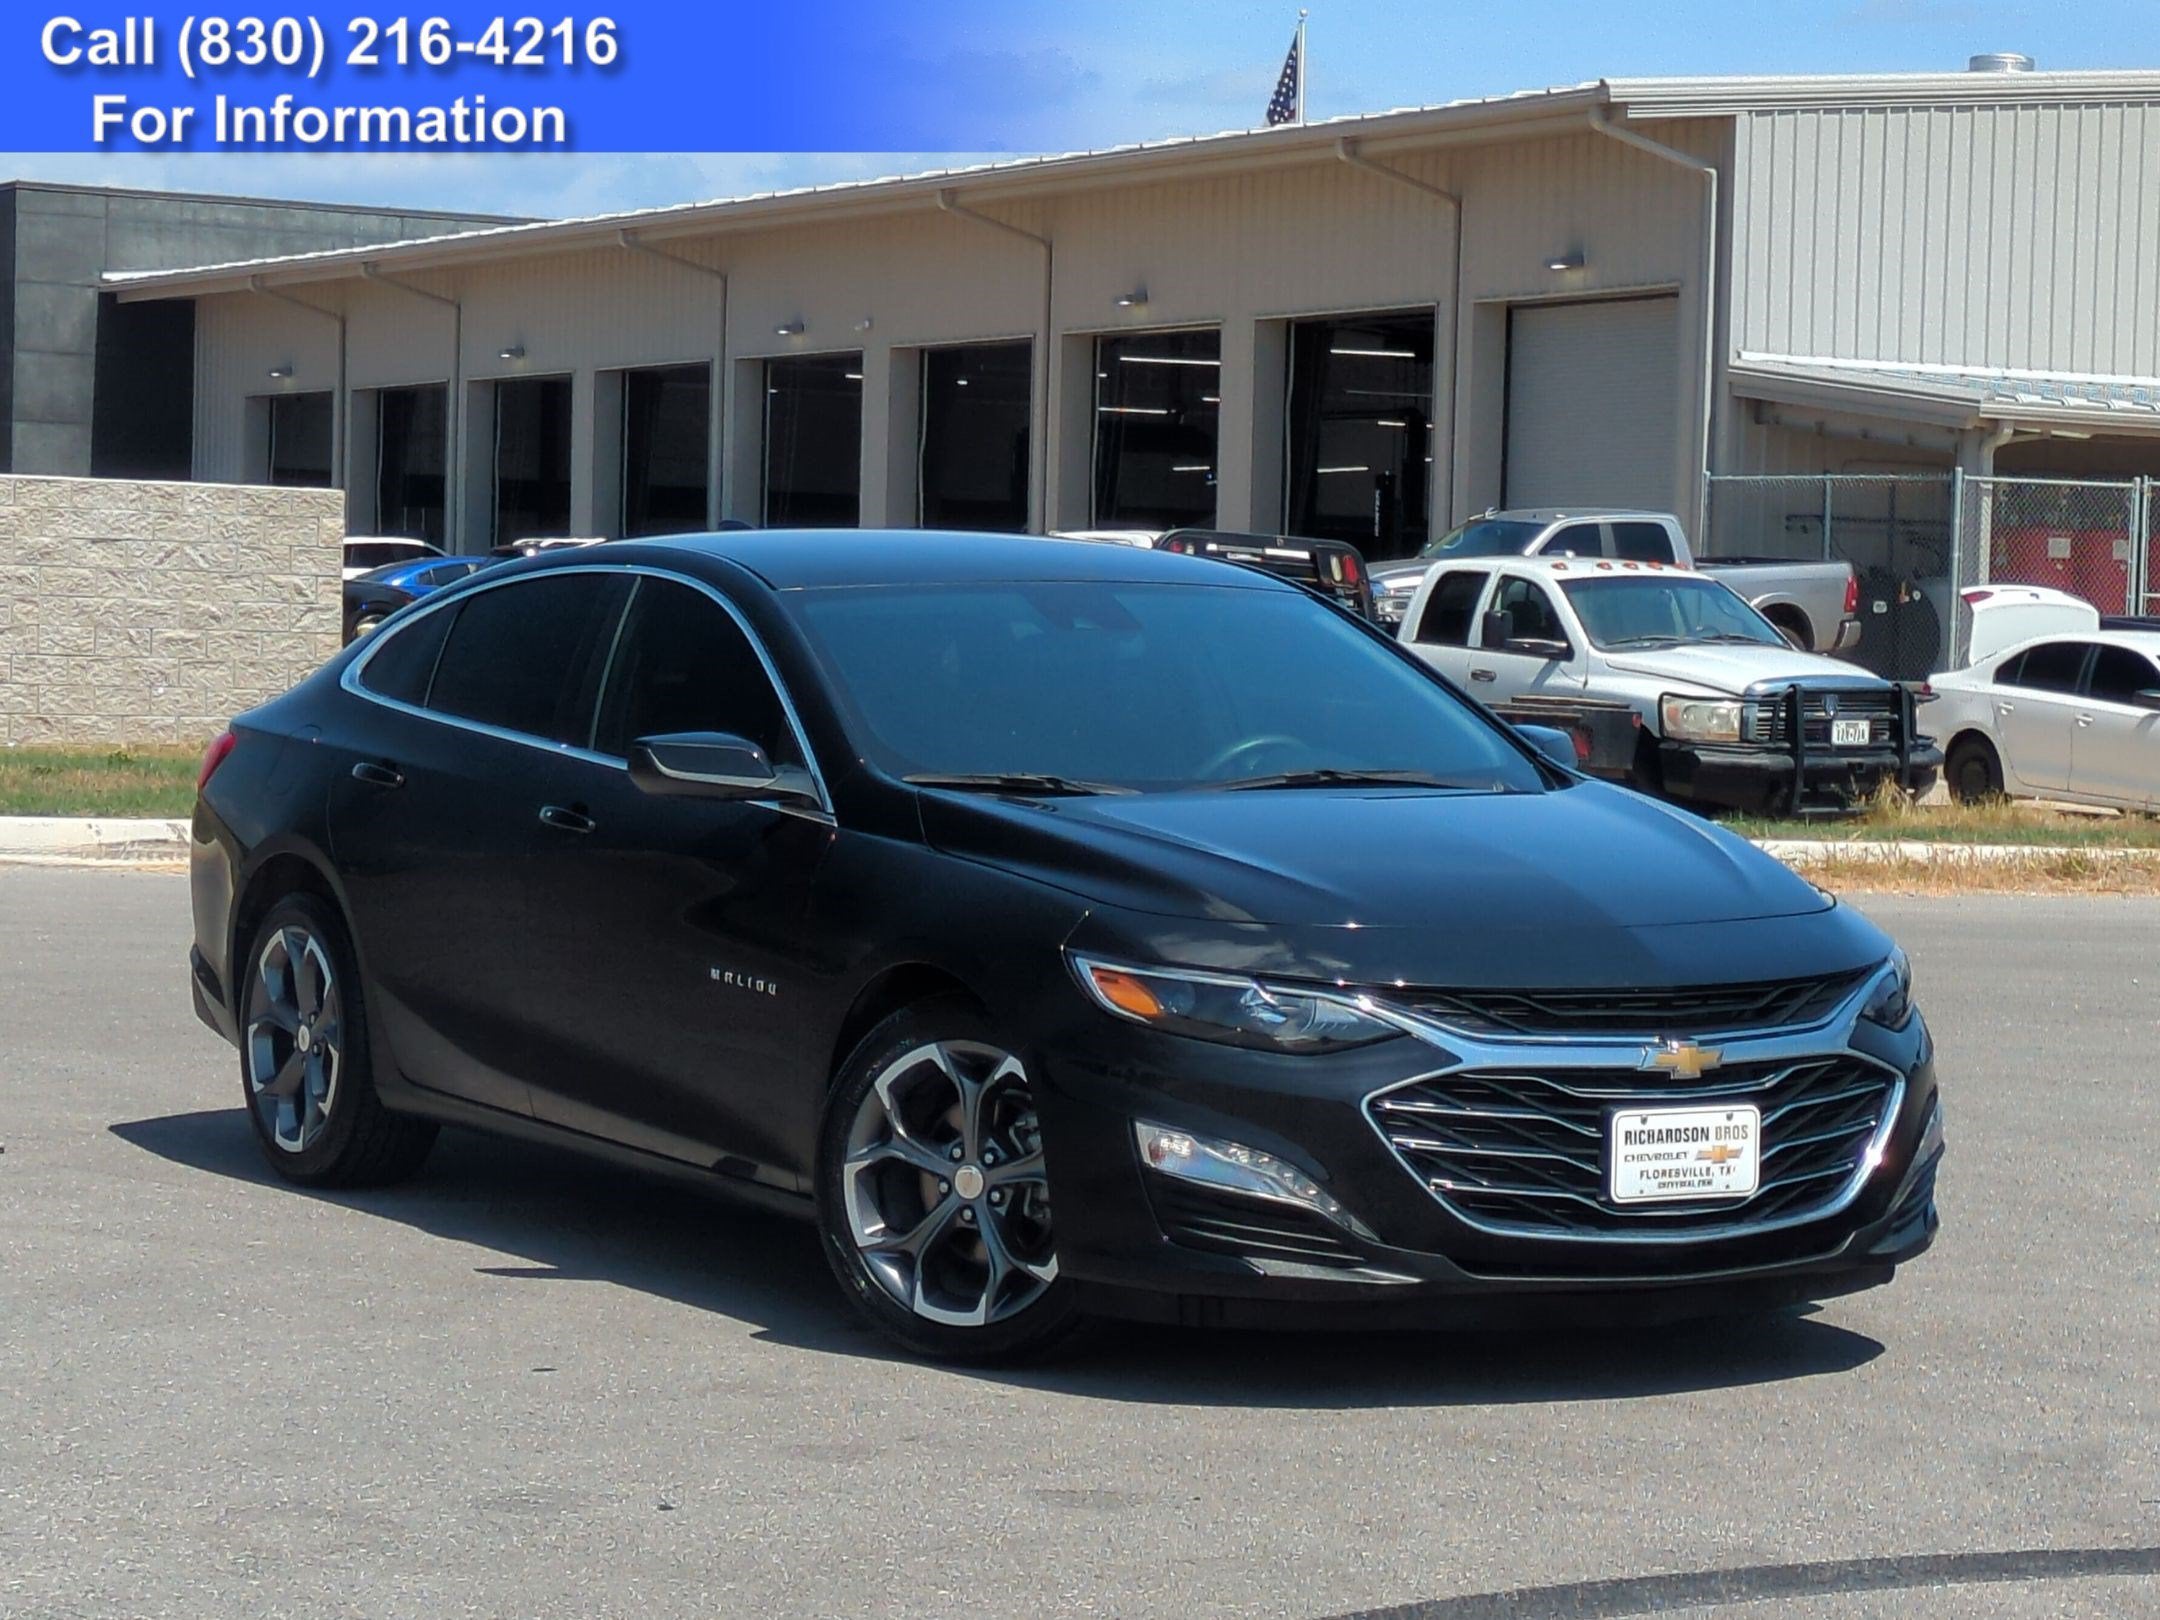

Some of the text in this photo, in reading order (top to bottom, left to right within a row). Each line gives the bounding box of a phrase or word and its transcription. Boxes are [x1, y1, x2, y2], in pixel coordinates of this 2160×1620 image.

[1624, 1124, 1749, 1146] RICHARDSON BROS
[1624, 1151, 1689, 1163] CHEVROLET
